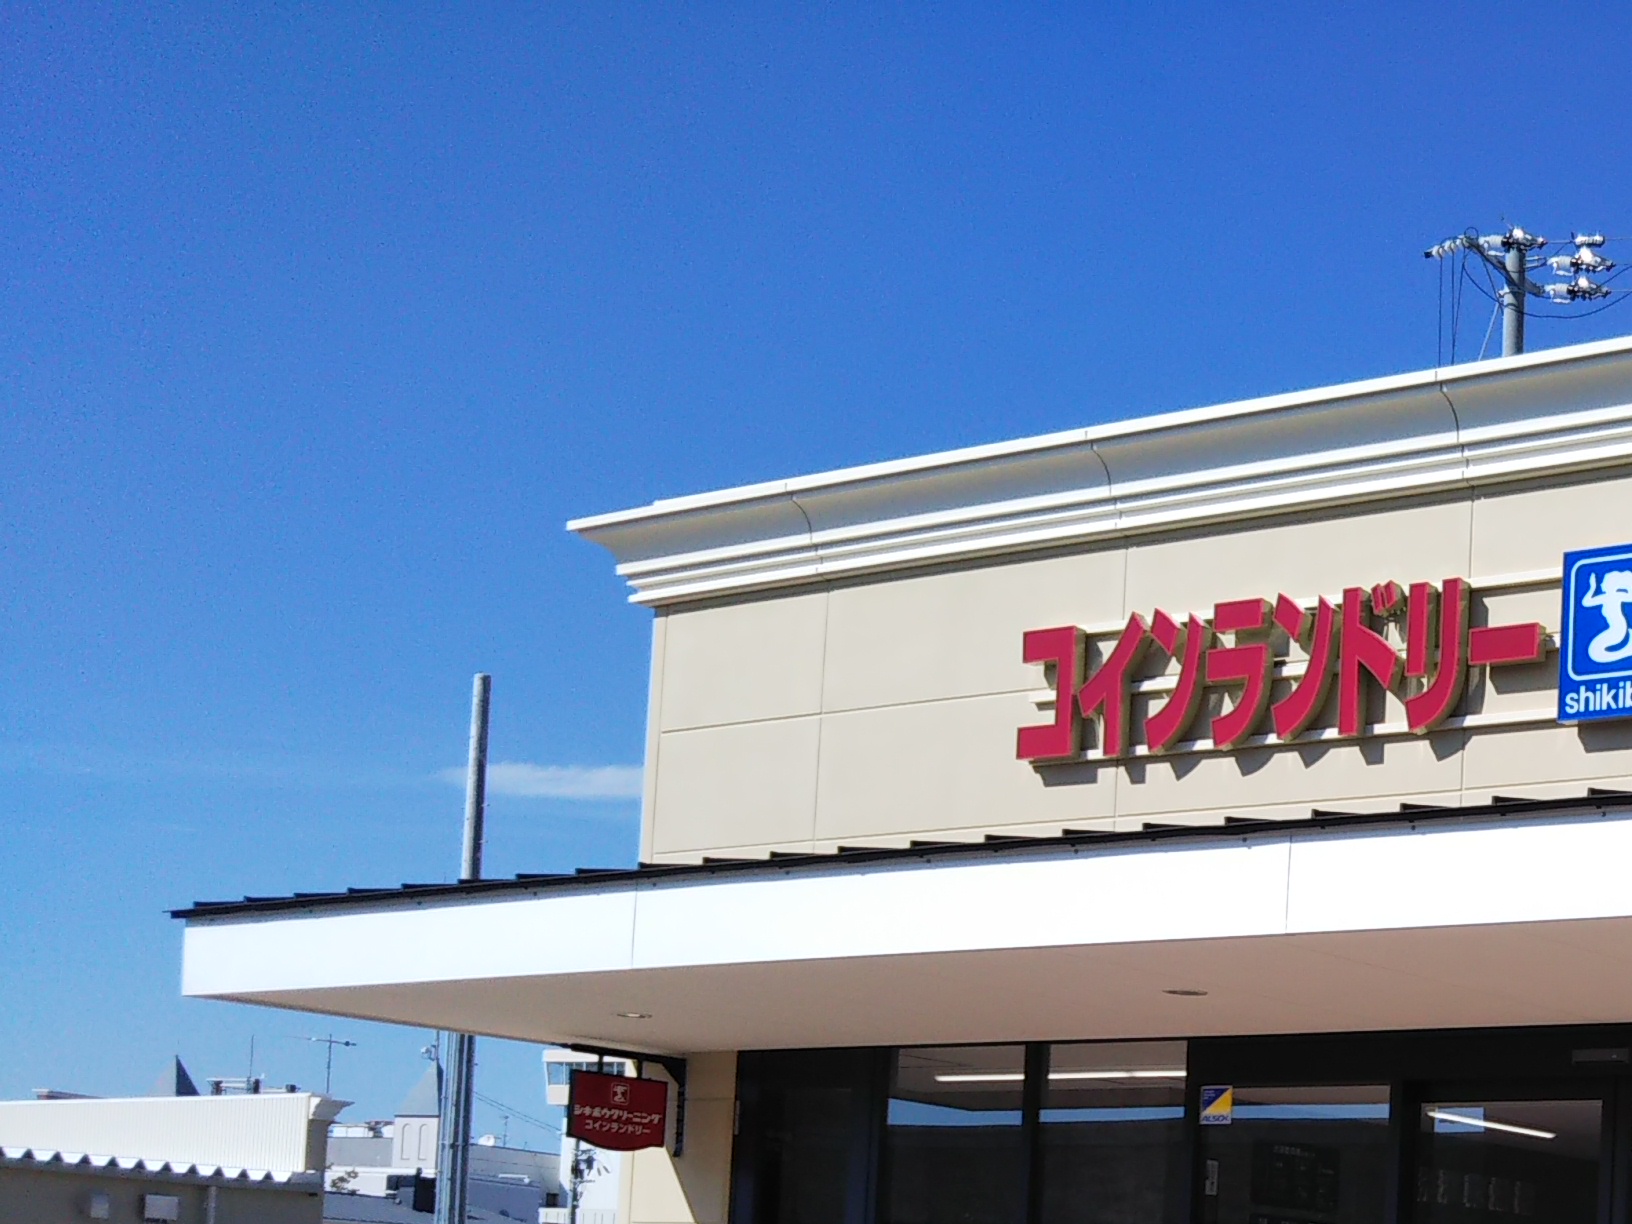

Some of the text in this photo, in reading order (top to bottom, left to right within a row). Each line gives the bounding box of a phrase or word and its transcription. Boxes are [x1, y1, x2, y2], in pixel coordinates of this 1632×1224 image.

[1016, 577, 1545, 760] コインランドリー
